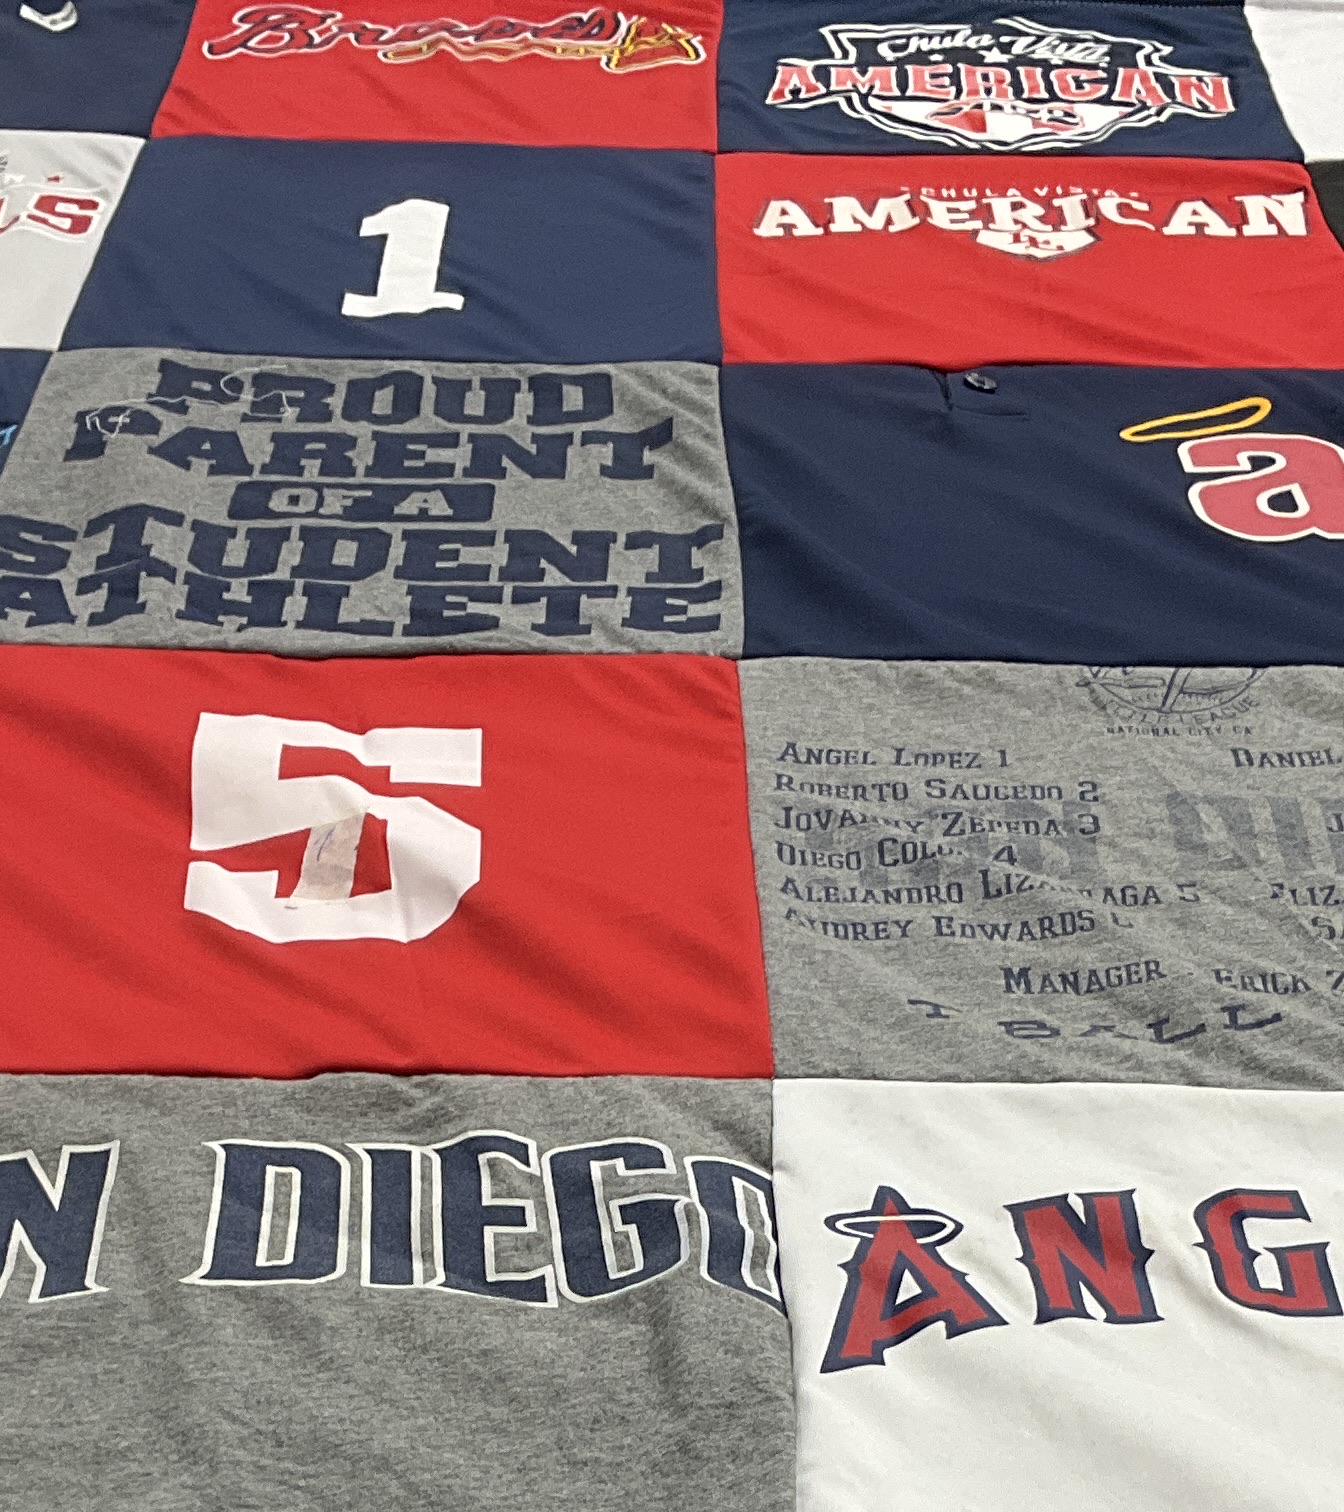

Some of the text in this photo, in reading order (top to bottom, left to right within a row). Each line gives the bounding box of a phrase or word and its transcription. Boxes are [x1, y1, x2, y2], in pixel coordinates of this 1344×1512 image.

[766, 63, 1236, 114] AMERICAN
[754, 192, 1308, 237] AMERICAN
[341, 199, 464, 318] 1
[148, 358, 612, 425] PROUD
[63, 407, 673, 480] PARENT
[268, 488, 453, 517] OF A
[774, 741, 1011, 769] ANGEL LOPEZ 1
[1230, 747, 1343, 768] DANIEL
[773, 773, 909, 802] ROBERTO
[1078, 780, 1099, 803] 2
[184, 712, 482, 943] 5
[1078, 814, 1100, 836] 3
[775, 837, 1017, 871] DIEGO COL 4
[779, 876, 964, 905] ALEJANDRO
[931, 909, 1096, 941] EDWARDS
[1000, 959, 1166, 996] MANAGER
[180, 1130, 789, 1319] DIEGO
